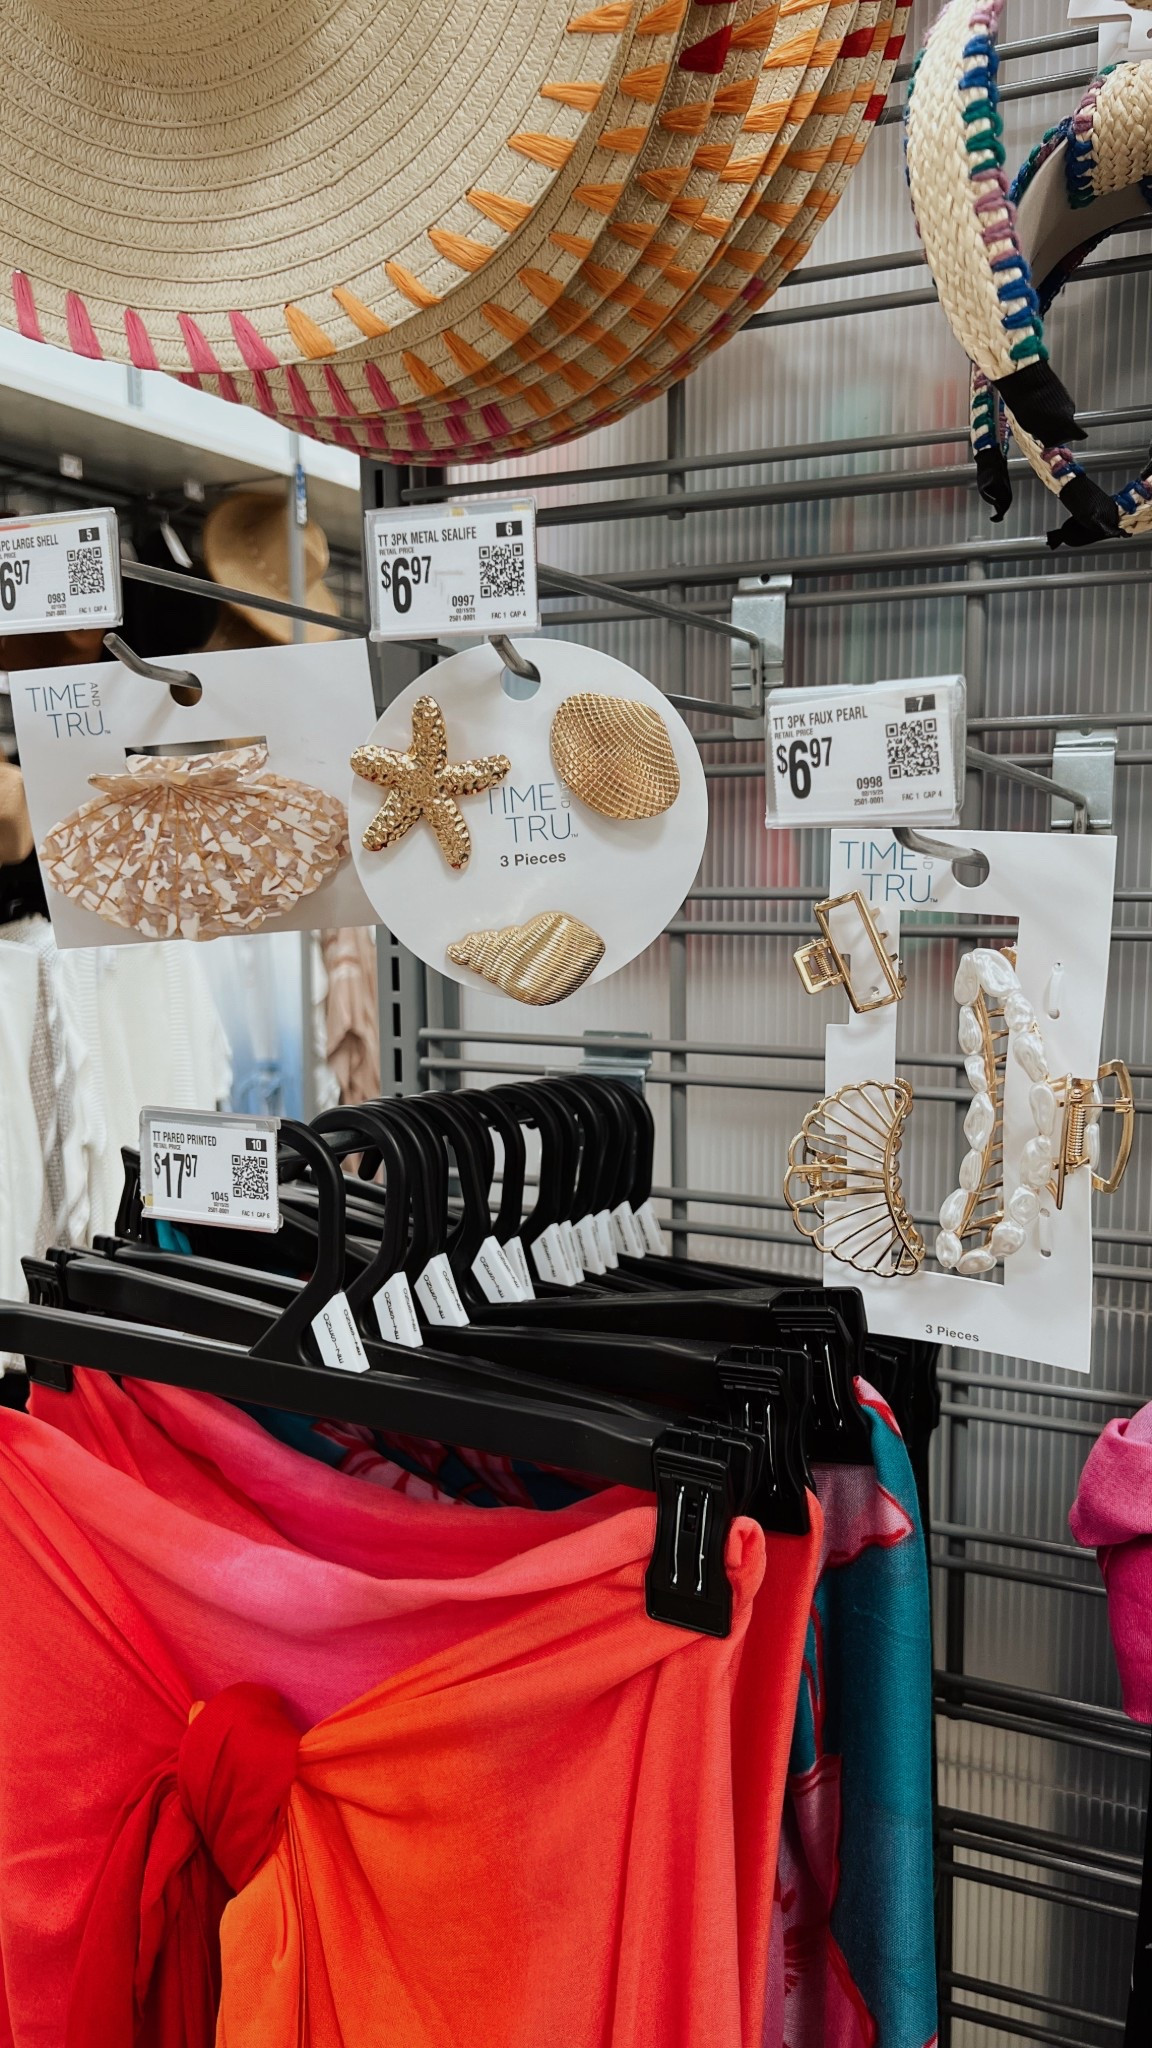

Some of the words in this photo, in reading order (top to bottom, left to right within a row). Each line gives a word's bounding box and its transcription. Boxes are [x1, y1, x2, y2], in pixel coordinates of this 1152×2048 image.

[86, 529, 93, 540] 5
[505, 522, 513, 536] 6
[0, 540, 10, 552] PC
[12, 537, 35, 550] LARGE
[37, 534, 59, 547] SHELL
[378, 534, 388, 547] TT
[391, 532, 408, 546] 3PK
[410, 530, 439, 545] METAL
[441, 527, 477, 542] SEALIFE
[379, 548, 397, 556] RETAIL
[398, 547, 415, 555] PRICE
[47, 592, 66, 604] 0983
[451, 595, 475, 607] 0997
[24, 682, 90, 713] TIME
[89, 682, 101, 708] AND
[916, 697, 924, 711] 7
[773, 717, 784, 730] TT
[787, 714, 806, 729] 3PK
[809, 710, 833, 726] FAUX
[836, 706, 868, 722] PEARL
[774, 731, 794, 740] RETAIL
[795, 728, 814, 737] PRICE
[856, 776, 883, 790] 0998
[488, 782, 557, 815] TIME
[902, 793, 913, 801] FAC
[923, 791, 936, 799] CAP
[500, 855, 509, 867] 3
[514, 852, 567, 867] Pieces
[839, 841, 918, 871] TIME
[152, 1130, 161, 1141] TT
[187, 1133, 217, 1147] PRINTED
[251, 1140, 262, 1151] 10
[210, 1191, 229, 1202] 1045
[925, 1324, 933, 1334] 3
[937, 1325, 980, 1342] Pieces
